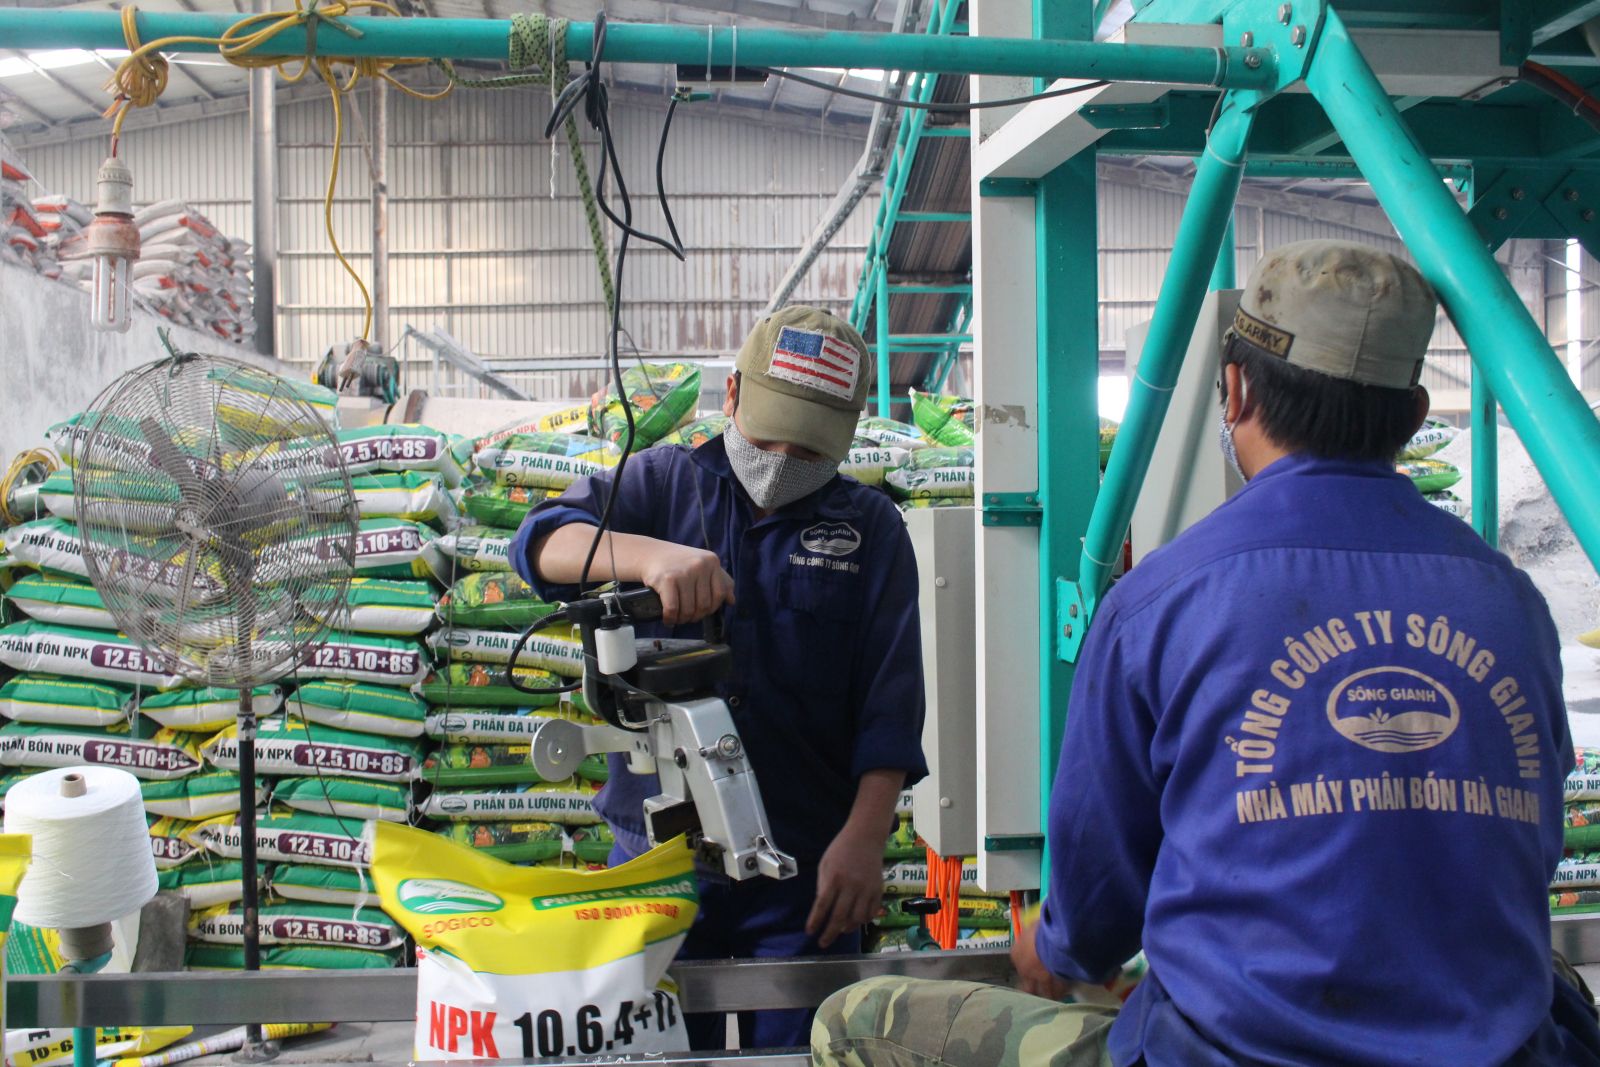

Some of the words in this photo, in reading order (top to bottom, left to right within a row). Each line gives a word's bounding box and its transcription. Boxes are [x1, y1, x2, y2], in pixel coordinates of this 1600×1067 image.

[1416, 431, 1443, 446] 5-10-3
[520, 454, 553, 471] PHÂN
[555, 460, 571, 473] ĐA
[854, 451, 892, 464] 5-10-3
[933, 470, 966, 483] PHÂN
[36, 641, 60, 656] BÓN
[63, 645, 89, 660] NPK
[476, 634, 509, 649] PHÂN
[531, 640, 568, 658] LƯỢNG
[314, 648, 414, 675] 12.5.10+8S
[1224, 688, 1291, 777] TỔNG
[1269, 617, 1357, 690] CÔNG
[1354, 609, 1395, 646] TY
[1406, 613, 1496, 683] SÔNG
[1489, 676, 1541, 779] GIANH
[1347, 685, 1388, 702] SÔNG
[1390, 687, 1437, 703] GIANH
[472, 718, 505, 732] PHÂN
[508, 721, 524, 733] ĐA
[28, 738, 53, 754] BÓN
[56, 743, 82, 757] NPK
[267, 747, 292, 760] NPK
[304, 747, 405, 774] 12.5.10+8S
[473, 796, 505, 810] PHÂN
[508, 799, 525, 809] ĐA
[527, 796, 566, 812] LƯỢNG
[568, 798, 592, 812] NPK
[1236, 781, 1288, 824] NHÀ
[1290, 774, 1344, 817] MÁY
[1350, 771, 1405, 812] PHÂN
[1409, 771, 1457, 812] BÓN
[1462, 775, 1494, 816] HÀ
[1576, 869, 1598, 880] NPK
[575, 907, 600, 920] ISO
[282, 921, 382, 946] 12.5.10+8S
[422, 916, 495, 939] SOGICO
[429, 1000, 500, 1059] NPK
